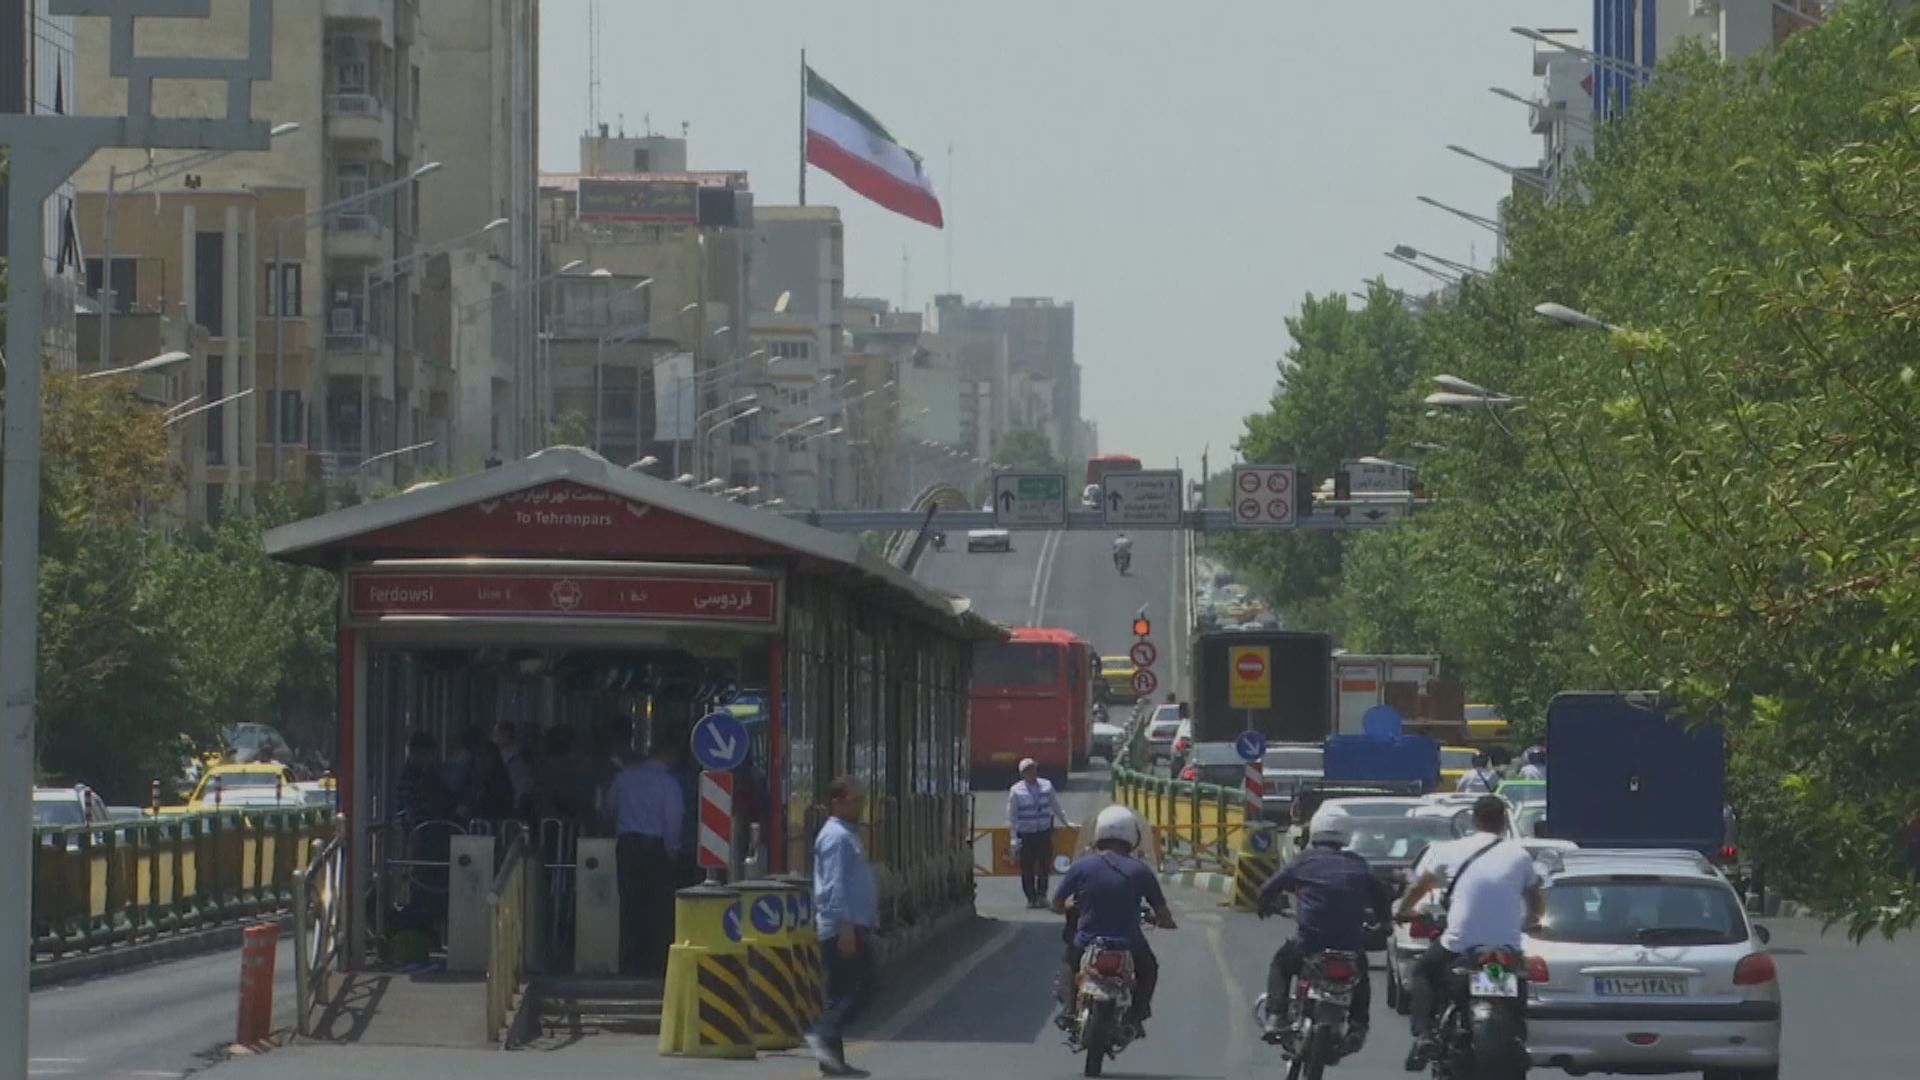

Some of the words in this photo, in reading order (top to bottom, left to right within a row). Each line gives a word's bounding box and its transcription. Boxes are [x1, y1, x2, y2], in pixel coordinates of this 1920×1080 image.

[516, 511, 532, 525] To
[535, 511, 613, 528] Tehranpars
[369, 585, 434, 602] Ferdowsi
[693, 586, 753, 610] فردوسی
